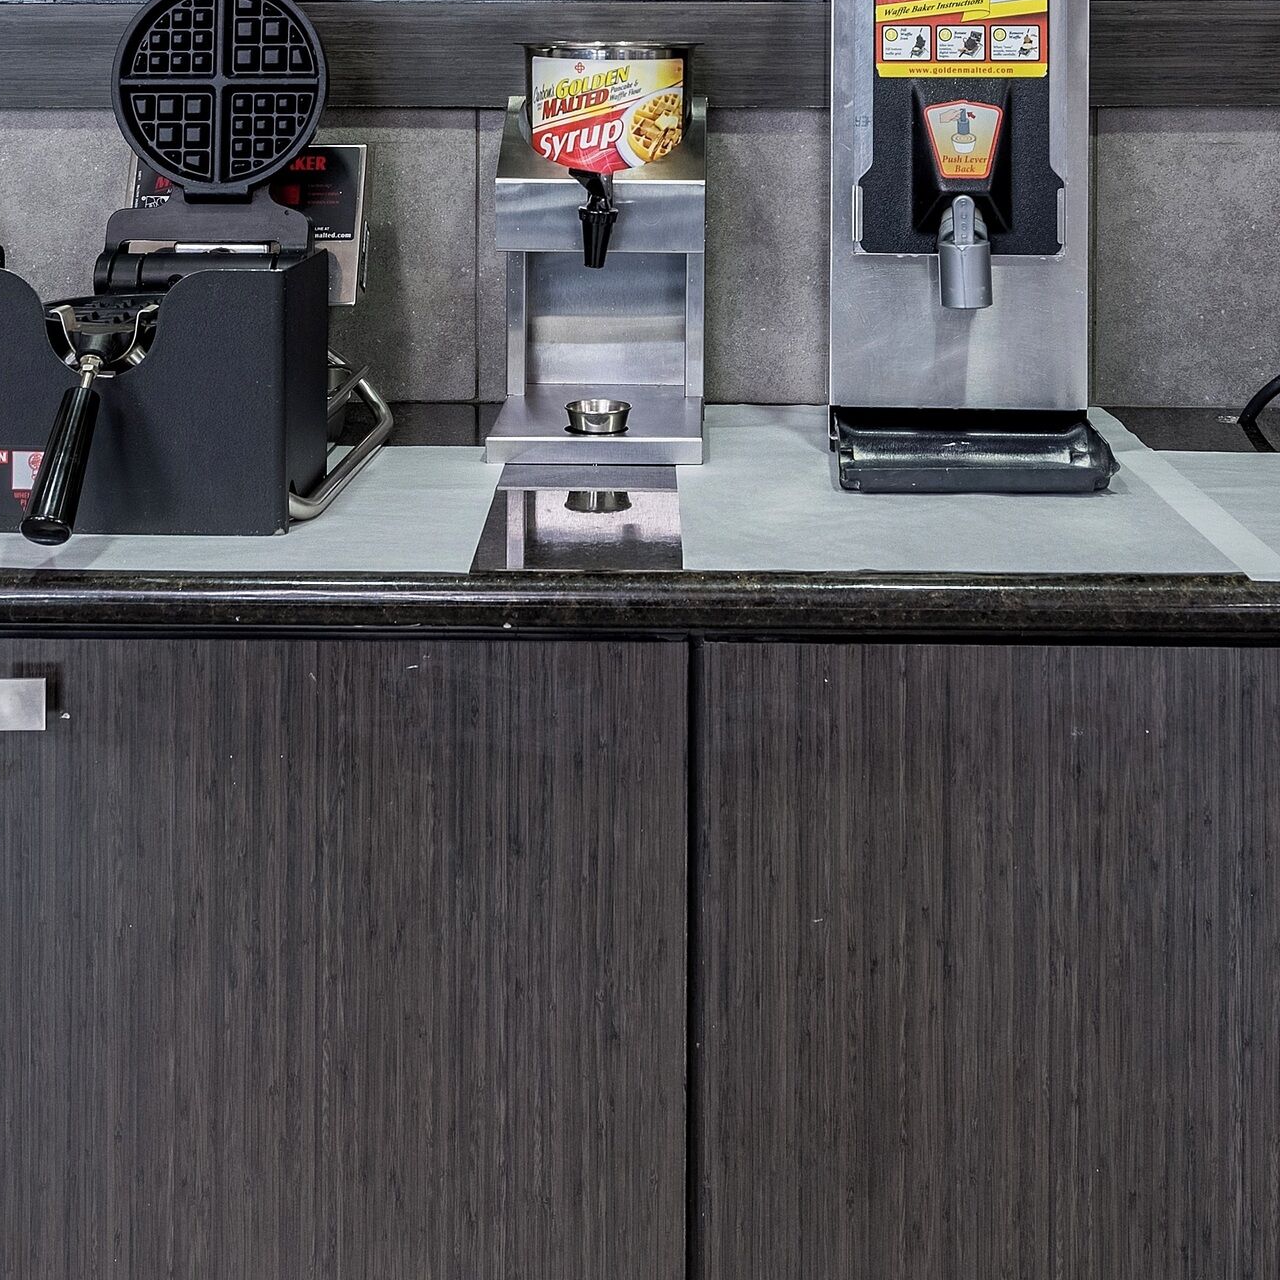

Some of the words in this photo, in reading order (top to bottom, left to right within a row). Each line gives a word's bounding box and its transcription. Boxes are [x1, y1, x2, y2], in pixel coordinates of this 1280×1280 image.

[884, 6, 909, 17] Waffle
[911, 3, 936, 13] Baker
[908, 65, 1014, 75] www.goldenmalted.com
[556, 65, 630, 99] GOLDEN
[610, 81, 633, 93] Pancake
[634, 79, 639, 87] &
[609, 91, 627, 101] Waffle
[542, 88, 609, 120] MALTED
[539, 118, 624, 161] Syrup
[942, 154, 963, 163] Push
[964, 155, 987, 163] Lever
[955, 164, 976, 173] Back
